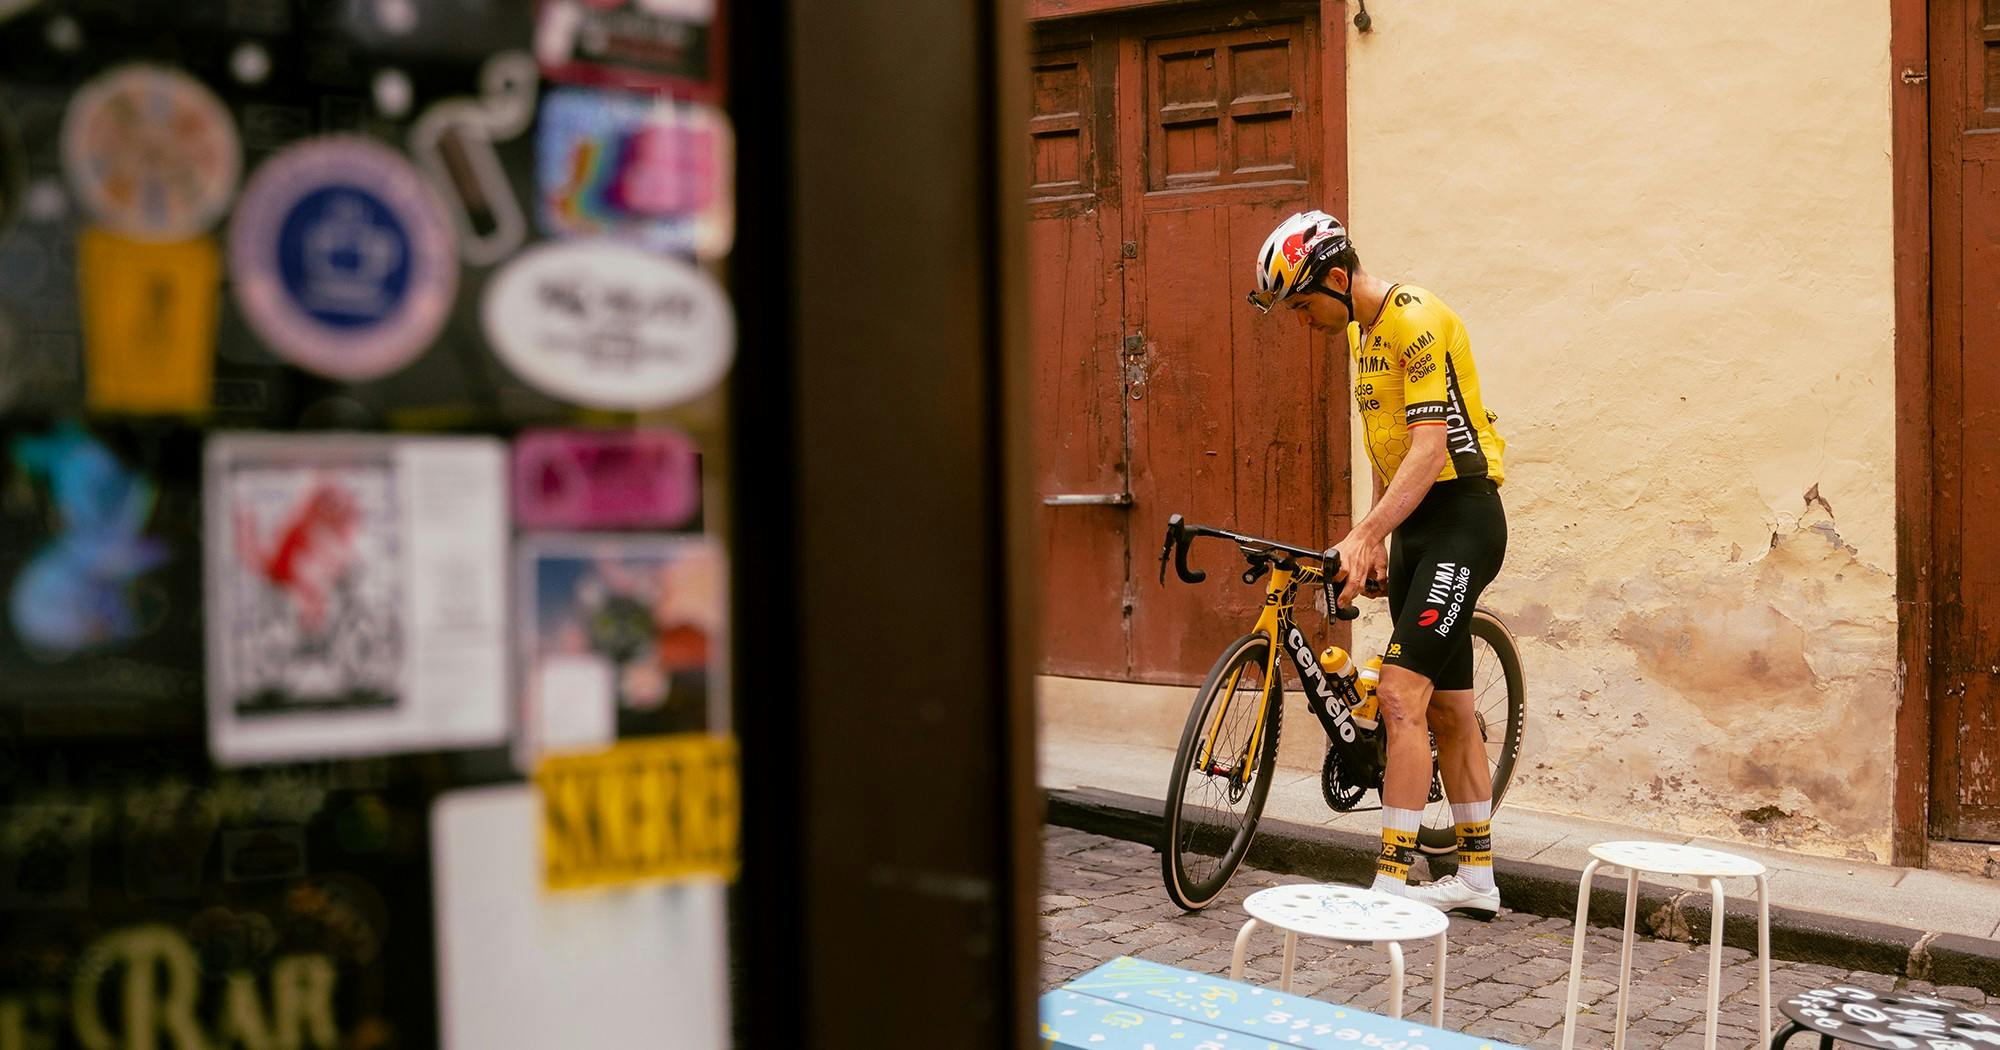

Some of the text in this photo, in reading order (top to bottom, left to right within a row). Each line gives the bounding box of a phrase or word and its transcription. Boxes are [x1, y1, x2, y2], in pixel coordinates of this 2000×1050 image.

[1404, 331, 1435, 359] VISMA
[1407, 405, 1443, 417] RAM
[1426, 562, 1456, 605] VISMA
[1435, 602, 1460, 638] lease
